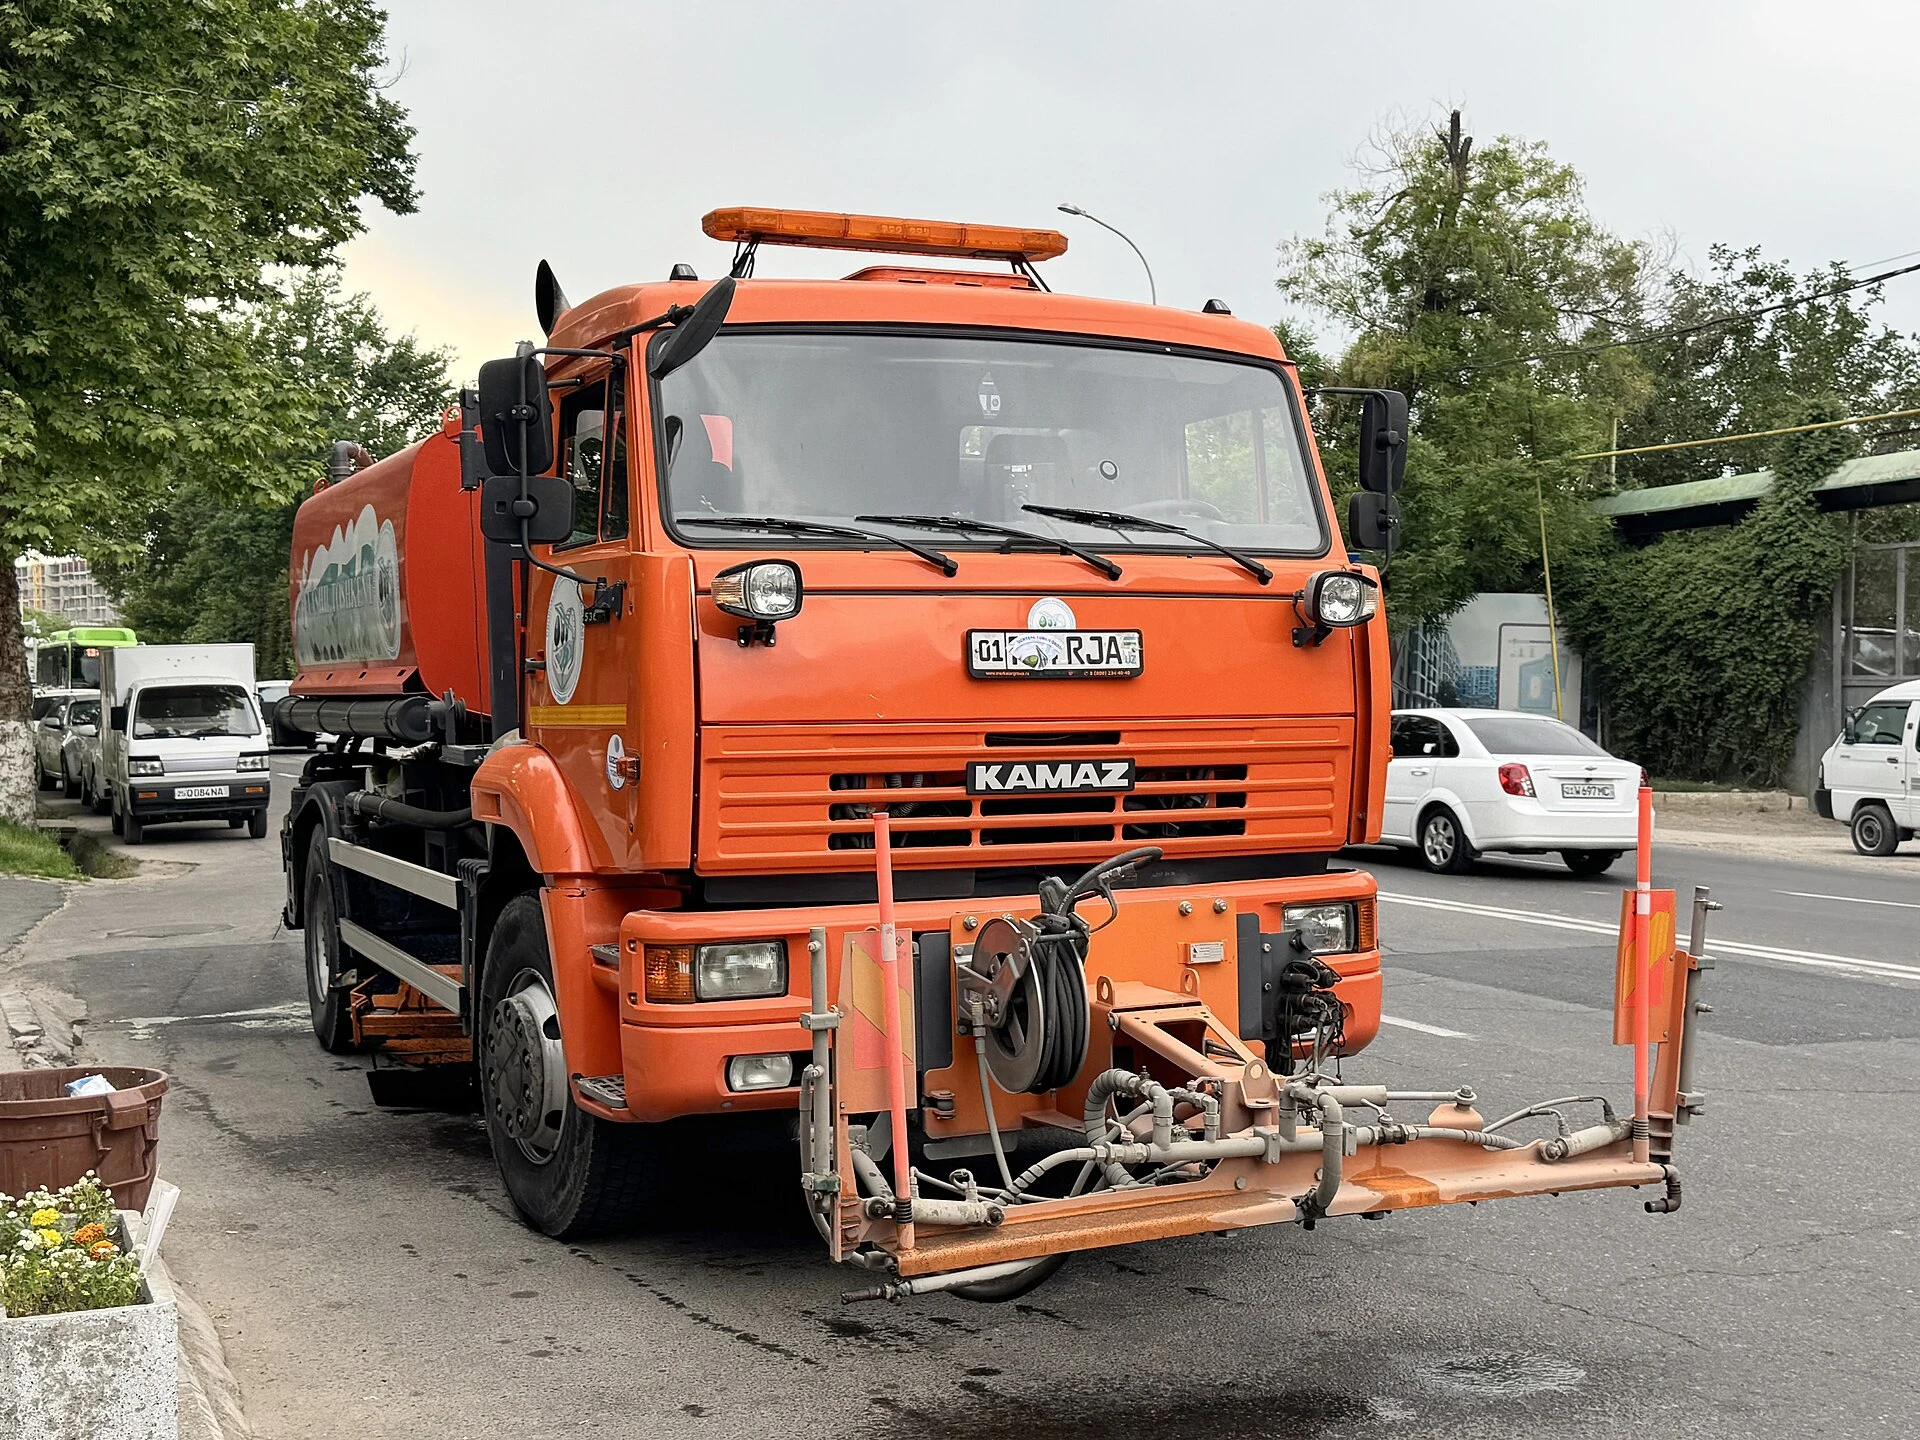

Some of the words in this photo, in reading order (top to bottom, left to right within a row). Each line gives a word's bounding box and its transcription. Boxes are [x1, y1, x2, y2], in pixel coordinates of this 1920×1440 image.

[979, 639, 1003, 662] 01
[1066, 636, 1122, 664] RJA
[1125, 654, 1137, 664] UZ
[975, 762, 1129, 790] KAMAZ
